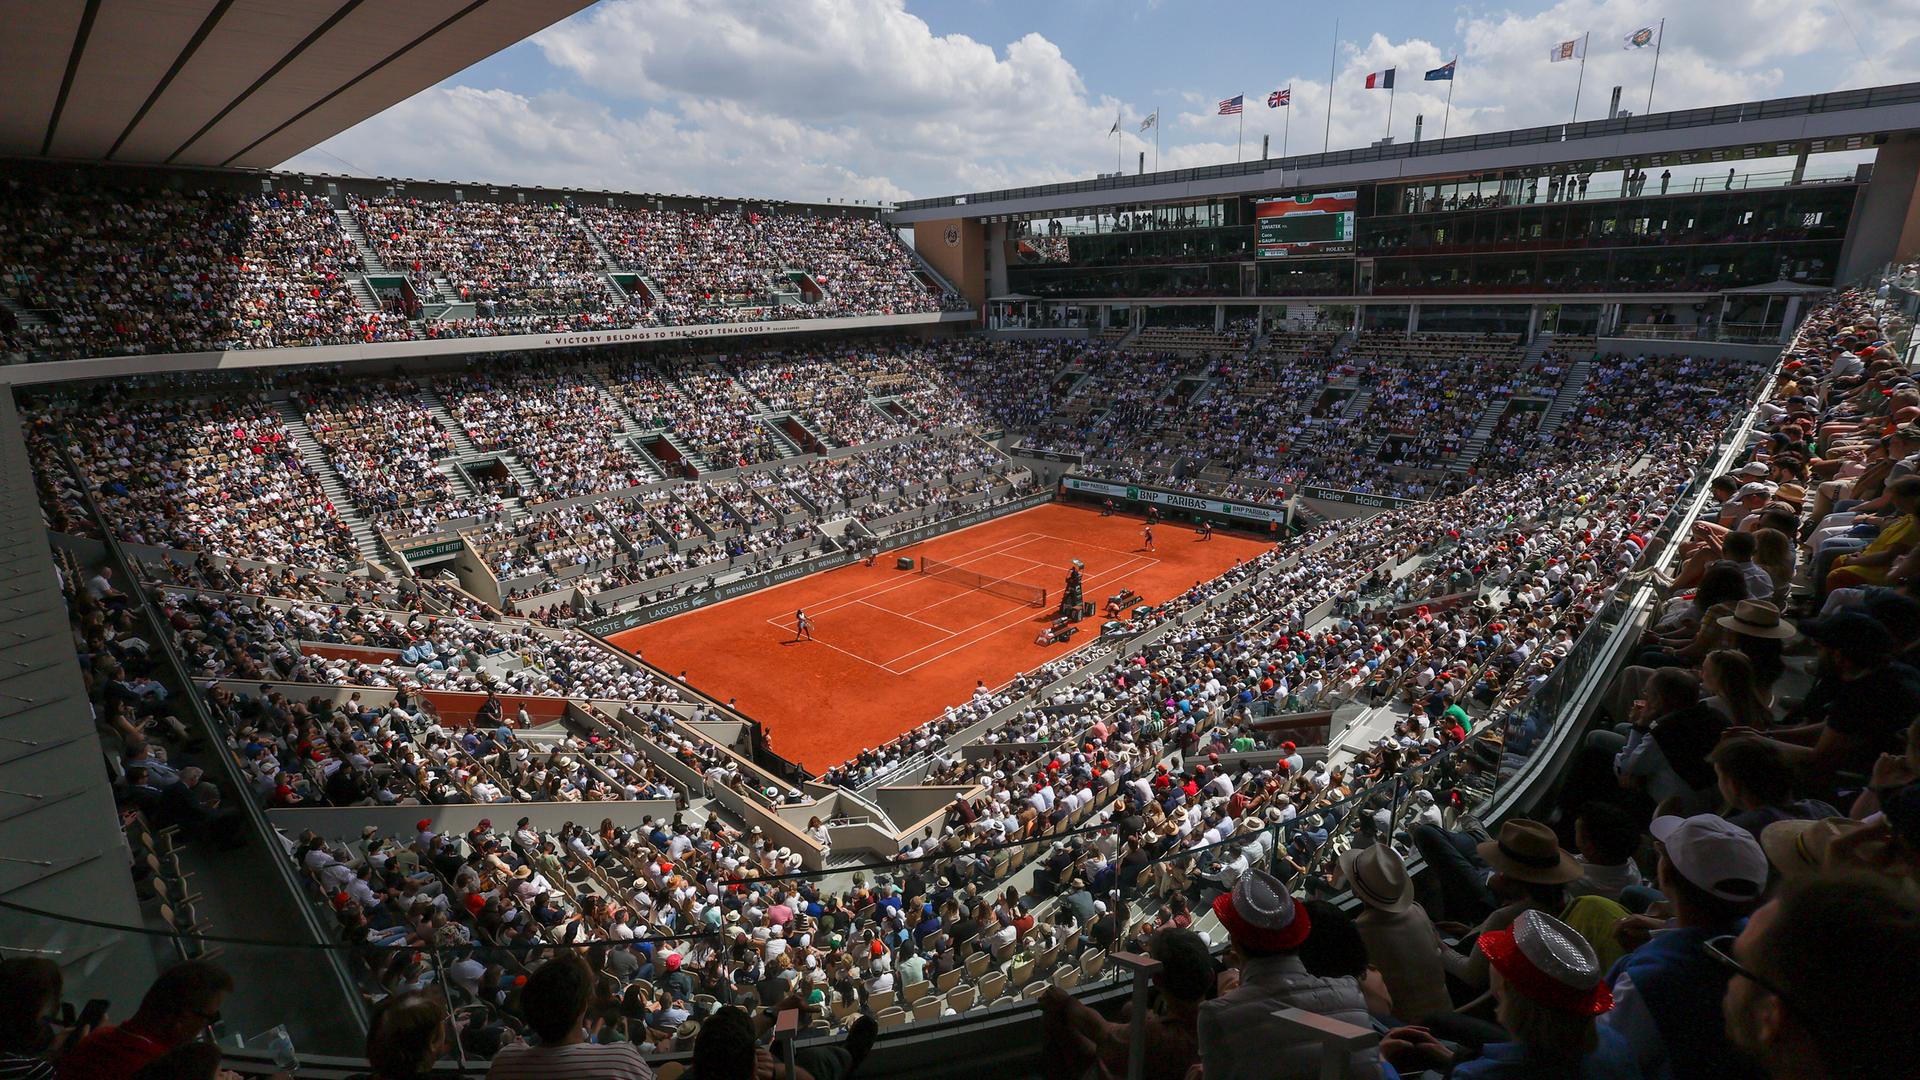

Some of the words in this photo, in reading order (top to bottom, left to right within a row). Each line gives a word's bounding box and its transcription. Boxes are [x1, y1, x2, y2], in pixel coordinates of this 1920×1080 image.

[556, 336, 601, 345] VICTORY
[606, 332, 650, 342] BELONGS
[654, 331, 666, 339] TO
[691, 328, 713, 337] MOST
[717, 326, 764, 334] TENACIOUS
[1140, 490, 1159, 501] BNP
[1167, 494, 1207, 510] PARIBAS
[1318, 490, 1344, 502] Haier
[1355, 495, 1383, 507] Haier
[1232, 505, 1245, 513] BNP
[1245, 507, 1270, 517] PARIBAS
[1394, 500, 1413, 510] Hai
[406, 548, 434, 560] mirates
[818, 555, 846, 568] RENAULT
[774, 567, 804, 581] RENAULT
[726, 581, 759, 595] RENAULT
[648, 600, 689, 619] LACOSTE
[589, 620, 621, 635] COSTE
